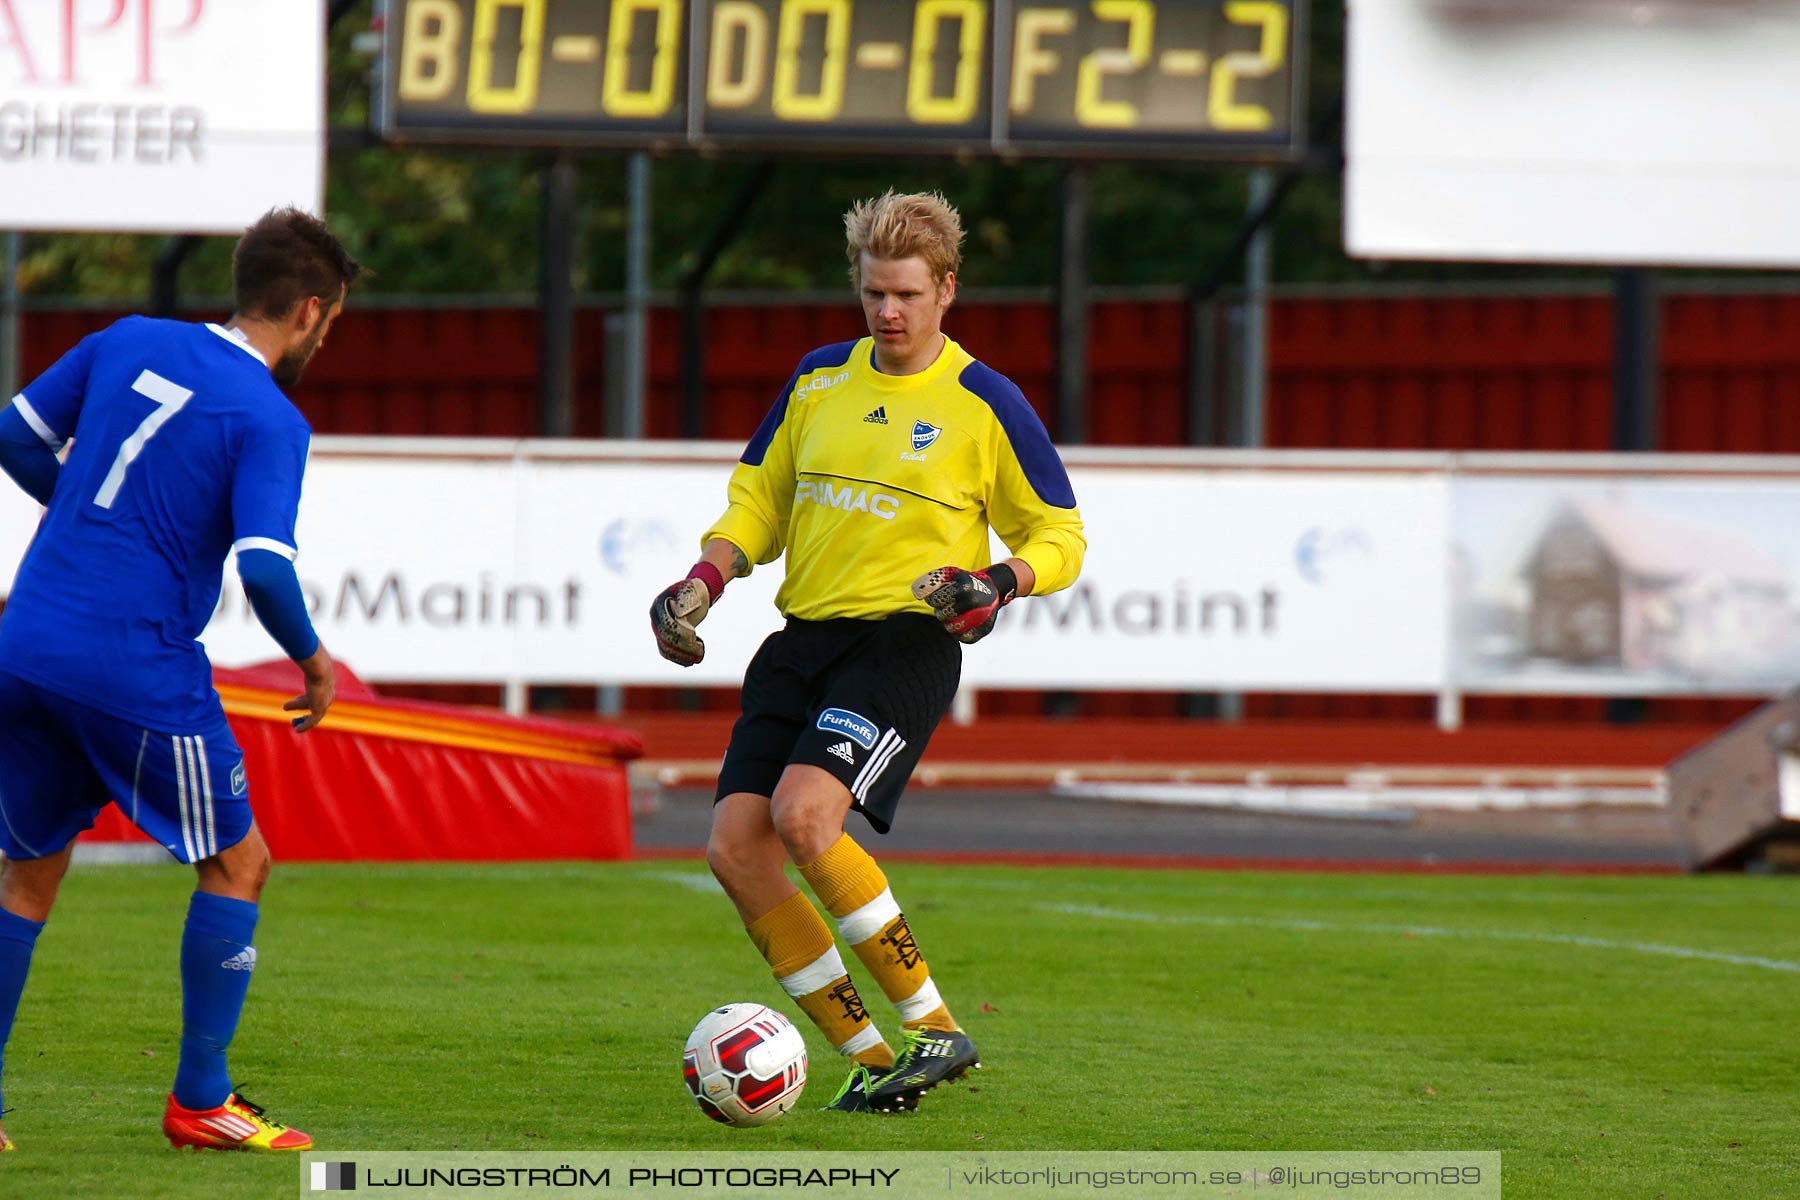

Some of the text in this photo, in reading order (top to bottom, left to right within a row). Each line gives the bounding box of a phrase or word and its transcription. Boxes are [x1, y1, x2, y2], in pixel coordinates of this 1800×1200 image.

[399, 0, 462, 100] B
[706, 3, 769, 108] D
[1009, 7, 1077, 114] F
[94, 369, 194, 509] 7
[863, 415, 889, 425] adidas
[823, 713, 873, 741] Furhoffs
[826, 746, 855, 765] adidas
